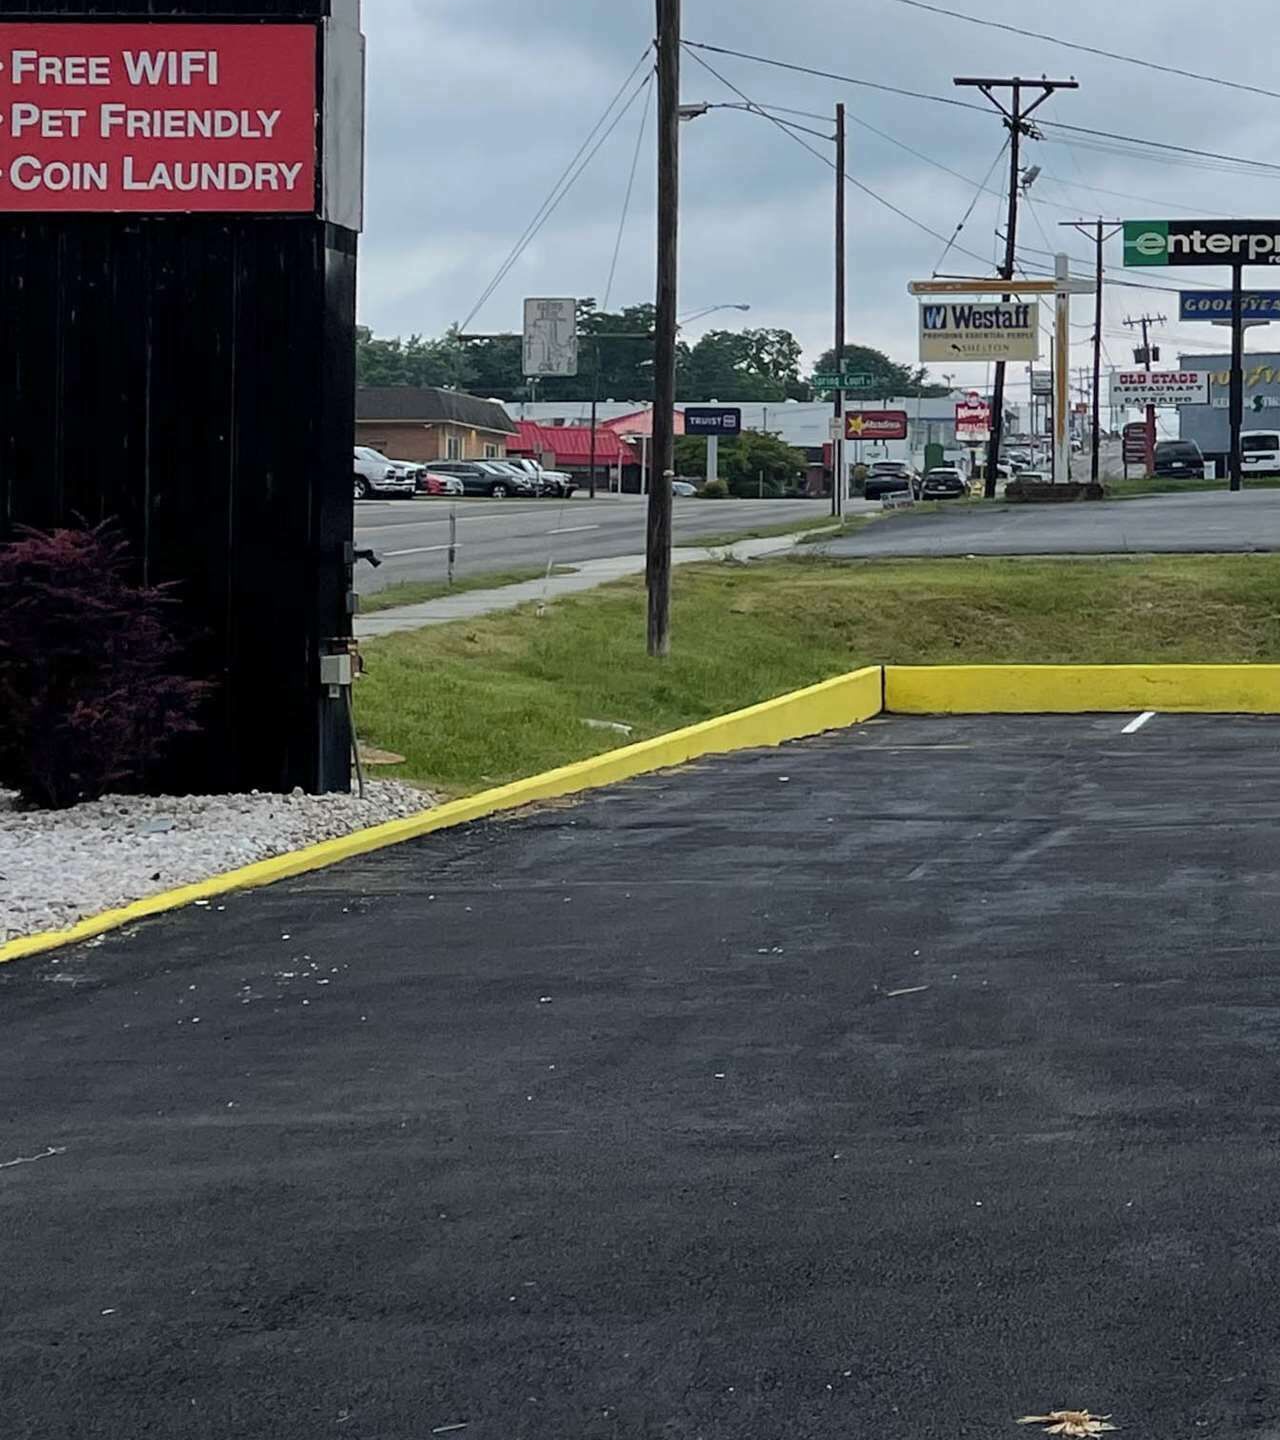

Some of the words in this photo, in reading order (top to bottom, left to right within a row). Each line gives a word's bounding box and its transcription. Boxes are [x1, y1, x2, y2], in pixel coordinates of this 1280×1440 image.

[11, 50, 111, 85] FREE
[122, 50, 218, 85] WIFI
[11, 103, 87, 138] PET
[100, 103, 281, 138] FRIENDLY
[10, 155, 107, 191] COIN
[122, 156, 303, 191] LAUNDRY
[951, 305, 1030, 329] Westaff
[1119, 374, 1146, 384] OLD
[689, 416, 722, 425] TRUIST
